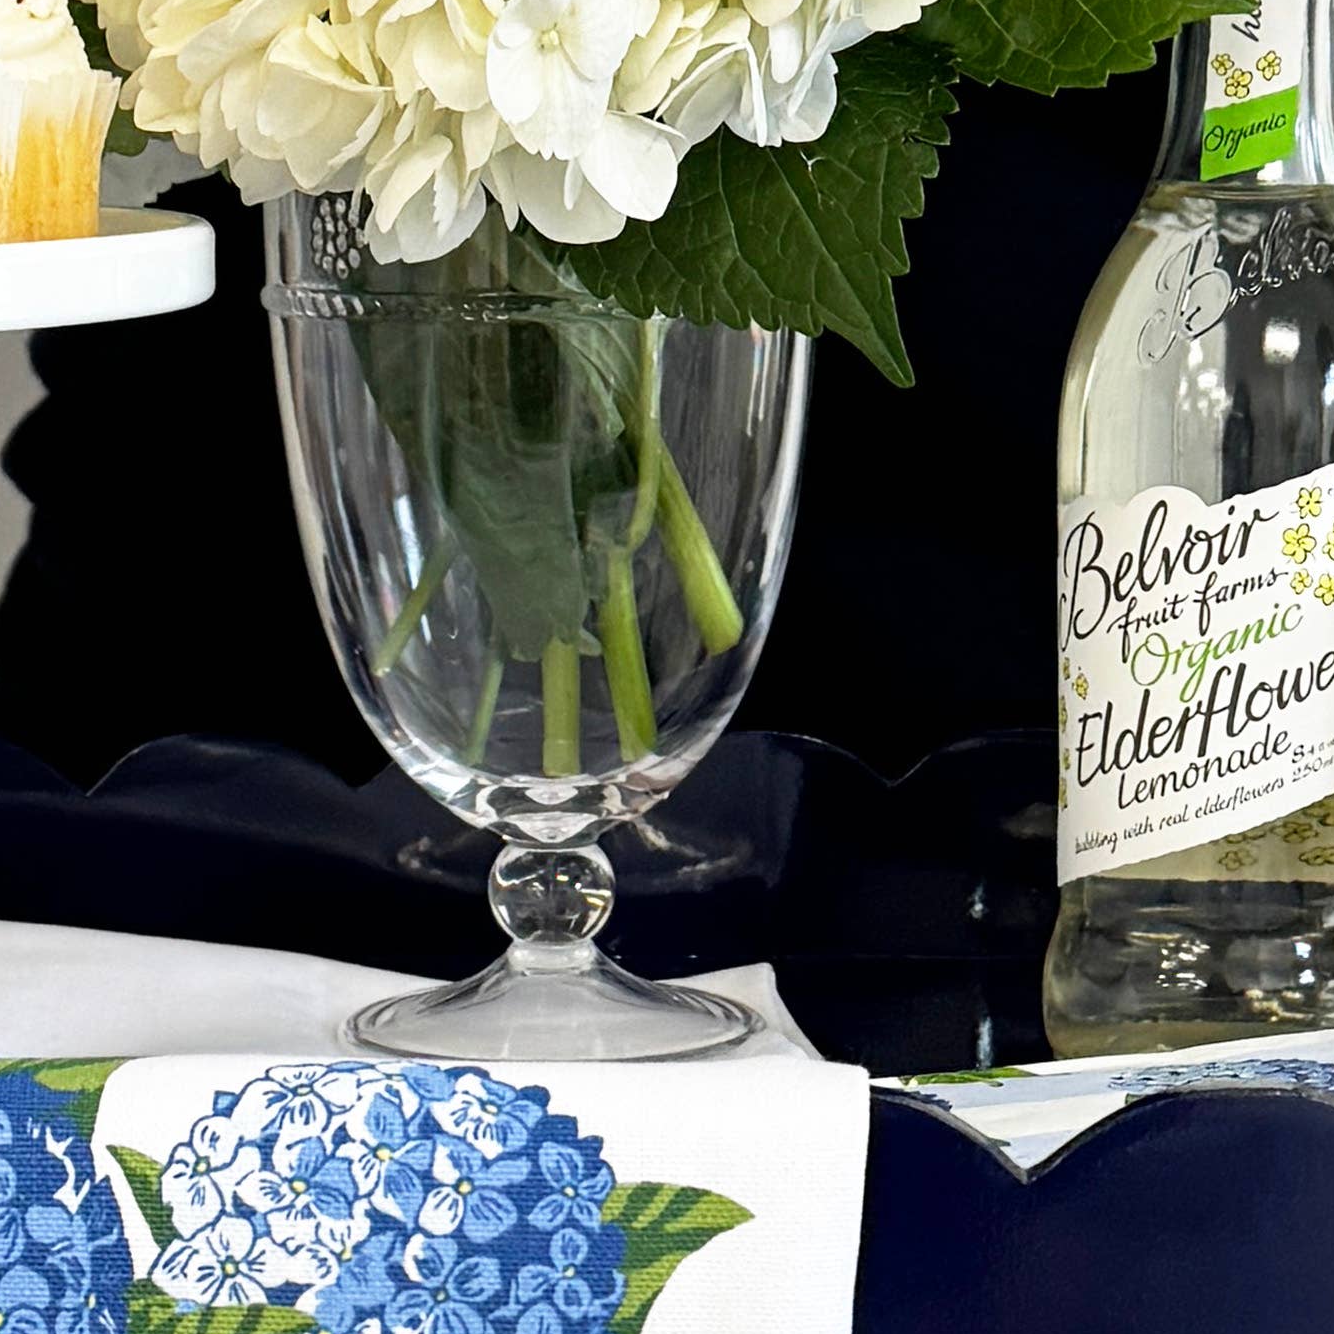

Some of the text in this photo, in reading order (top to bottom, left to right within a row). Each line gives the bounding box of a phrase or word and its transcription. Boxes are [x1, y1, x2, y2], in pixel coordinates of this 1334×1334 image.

[1203, 113, 1288, 159] Organic
[1059, 499, 1278, 652] Belvoir
[1106, 568, 1289, 664] fruit farms
[1130, 603, 1303, 703] Organic
[1118, 723, 1292, 811] Lemonade
[1123, 815, 1155, 840] with
[1158, 803, 1190, 831] real
[1194, 778, 1285, 818] elderflowers
